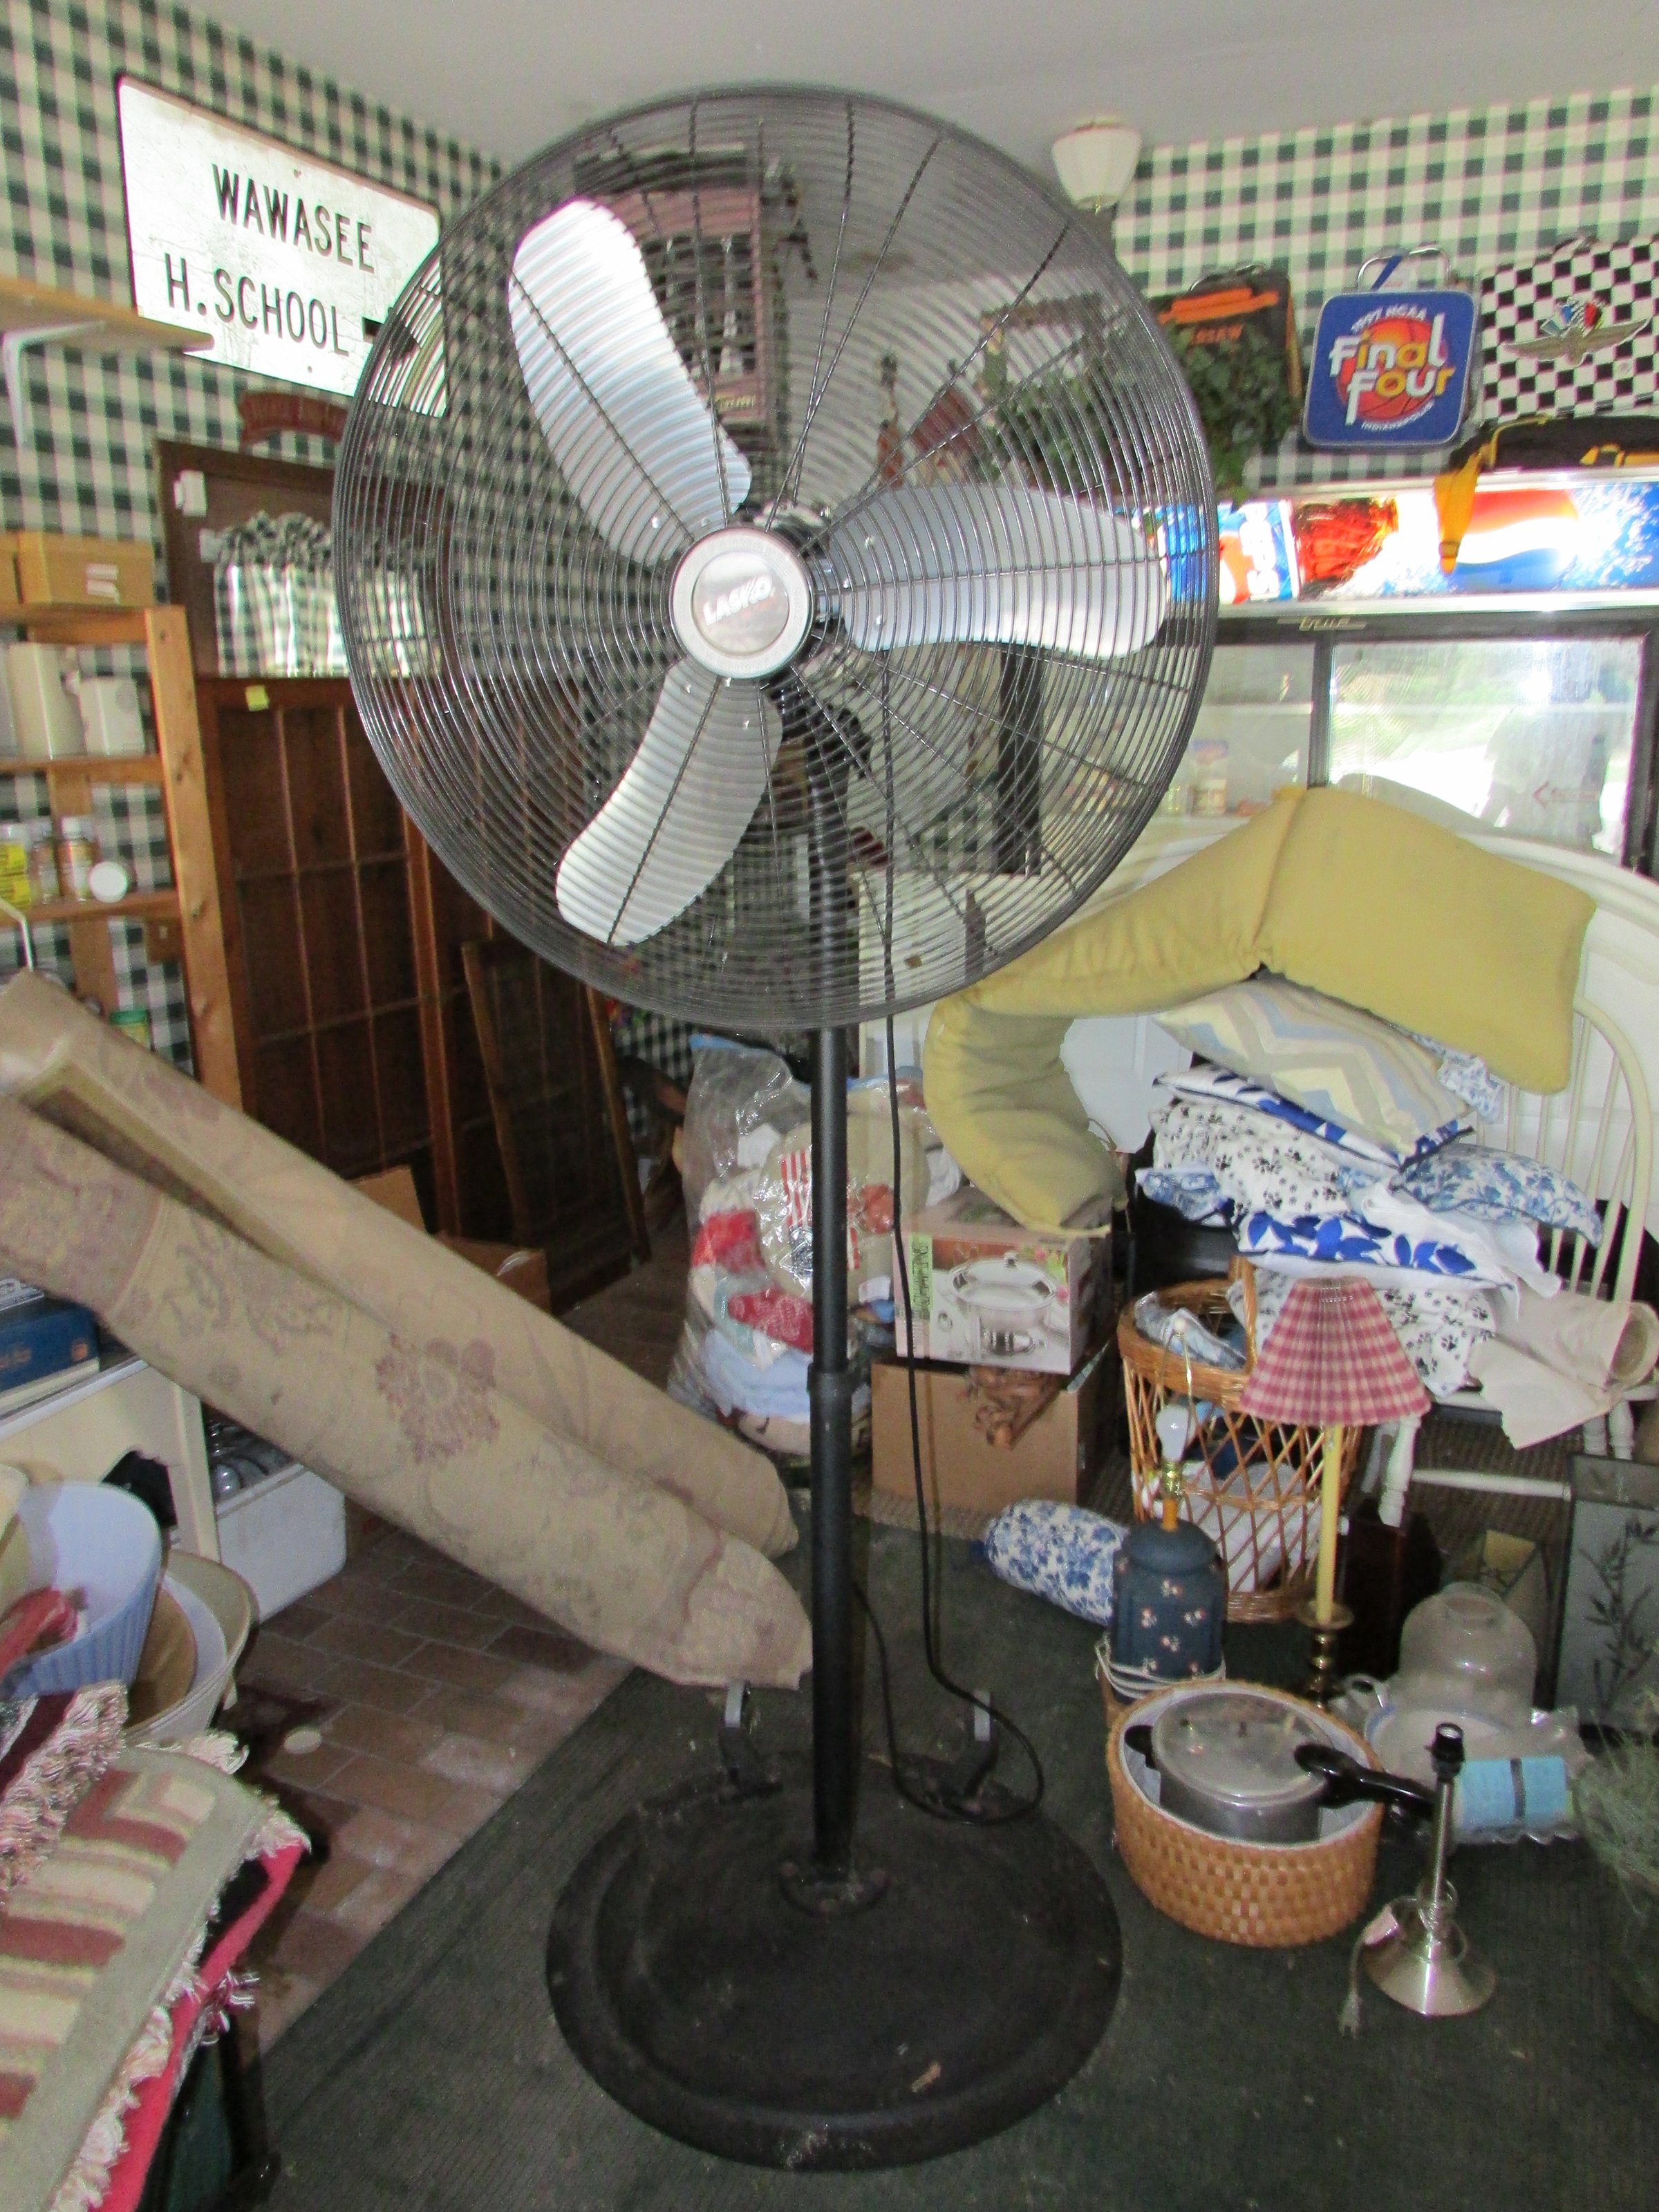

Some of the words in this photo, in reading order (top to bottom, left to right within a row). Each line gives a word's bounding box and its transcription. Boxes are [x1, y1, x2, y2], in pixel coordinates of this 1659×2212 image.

[212, 163, 375, 274] WAWASEE
[1385, 303, 1427, 321] NCAA
[1328, 312, 1445, 377] Final
[1344, 366, 1456, 426] Four
